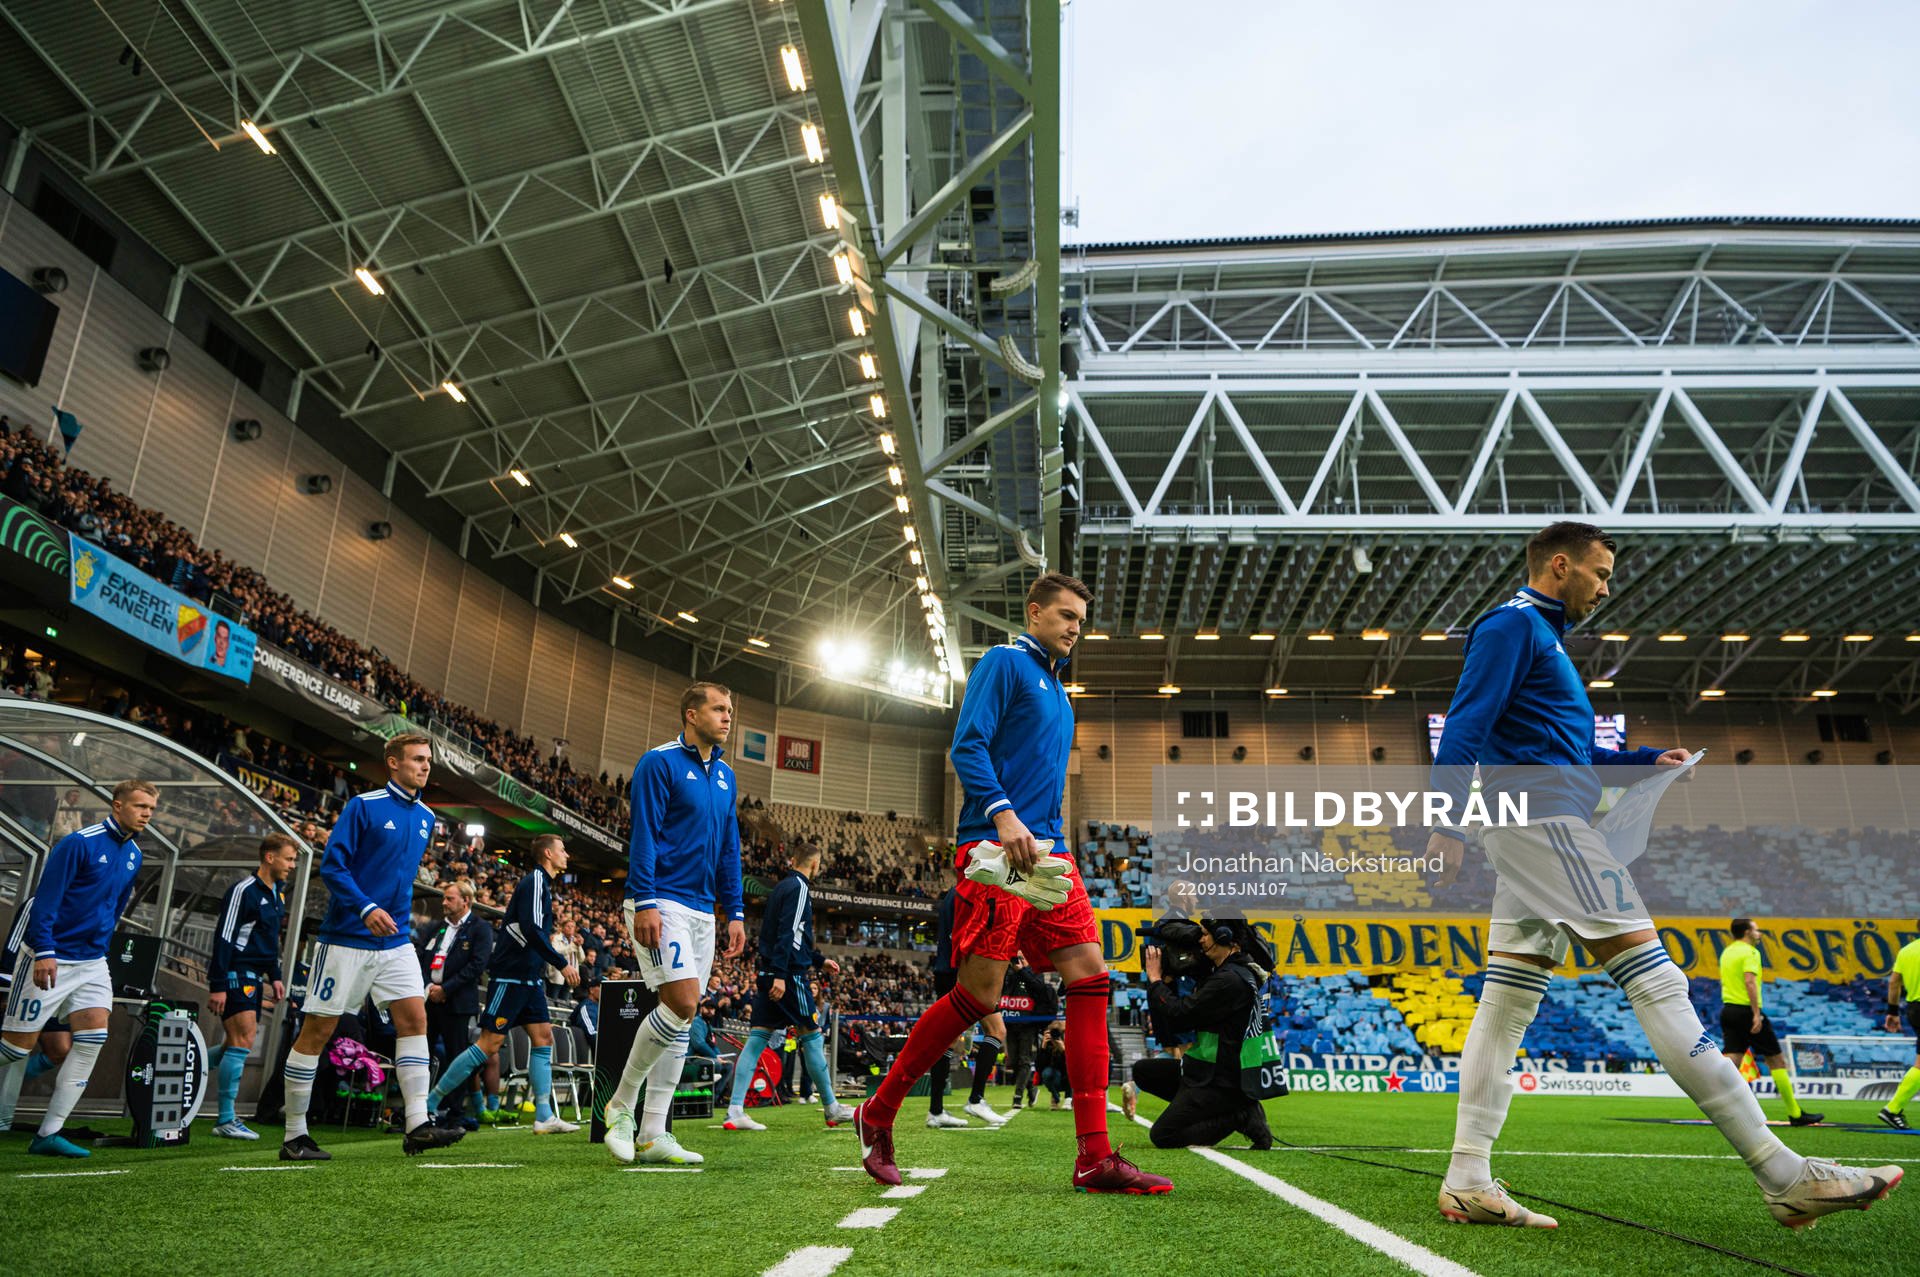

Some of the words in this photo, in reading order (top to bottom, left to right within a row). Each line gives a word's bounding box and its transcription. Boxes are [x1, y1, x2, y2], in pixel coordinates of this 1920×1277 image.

[107, 572, 173, 615] EXPERT-
[100, 584, 174, 635] PANELEN
[253, 645, 323, 695] CONFERENCE
[323, 684, 363, 716] LEAGUE
[787, 741, 809, 759] JOB
[784, 758, 812, 770] ZONE
[825, 893, 852, 904] EUROPA
[853, 896, 901, 909] CONFERENCE
[903, 902, 933, 911] LEAGUE
[987, 898, 996, 931] 1
[668, 941, 685, 969] 2
[319, 977, 335, 1001] 8
[19, 999, 42, 1022] 19
[1001, 995, 1029, 1008] HOTO
[183, 1040, 196, 1108] HUBLOT
[1283, 1067, 1380, 1092] ineken
[1540, 1075, 1632, 1095] Swissquote
